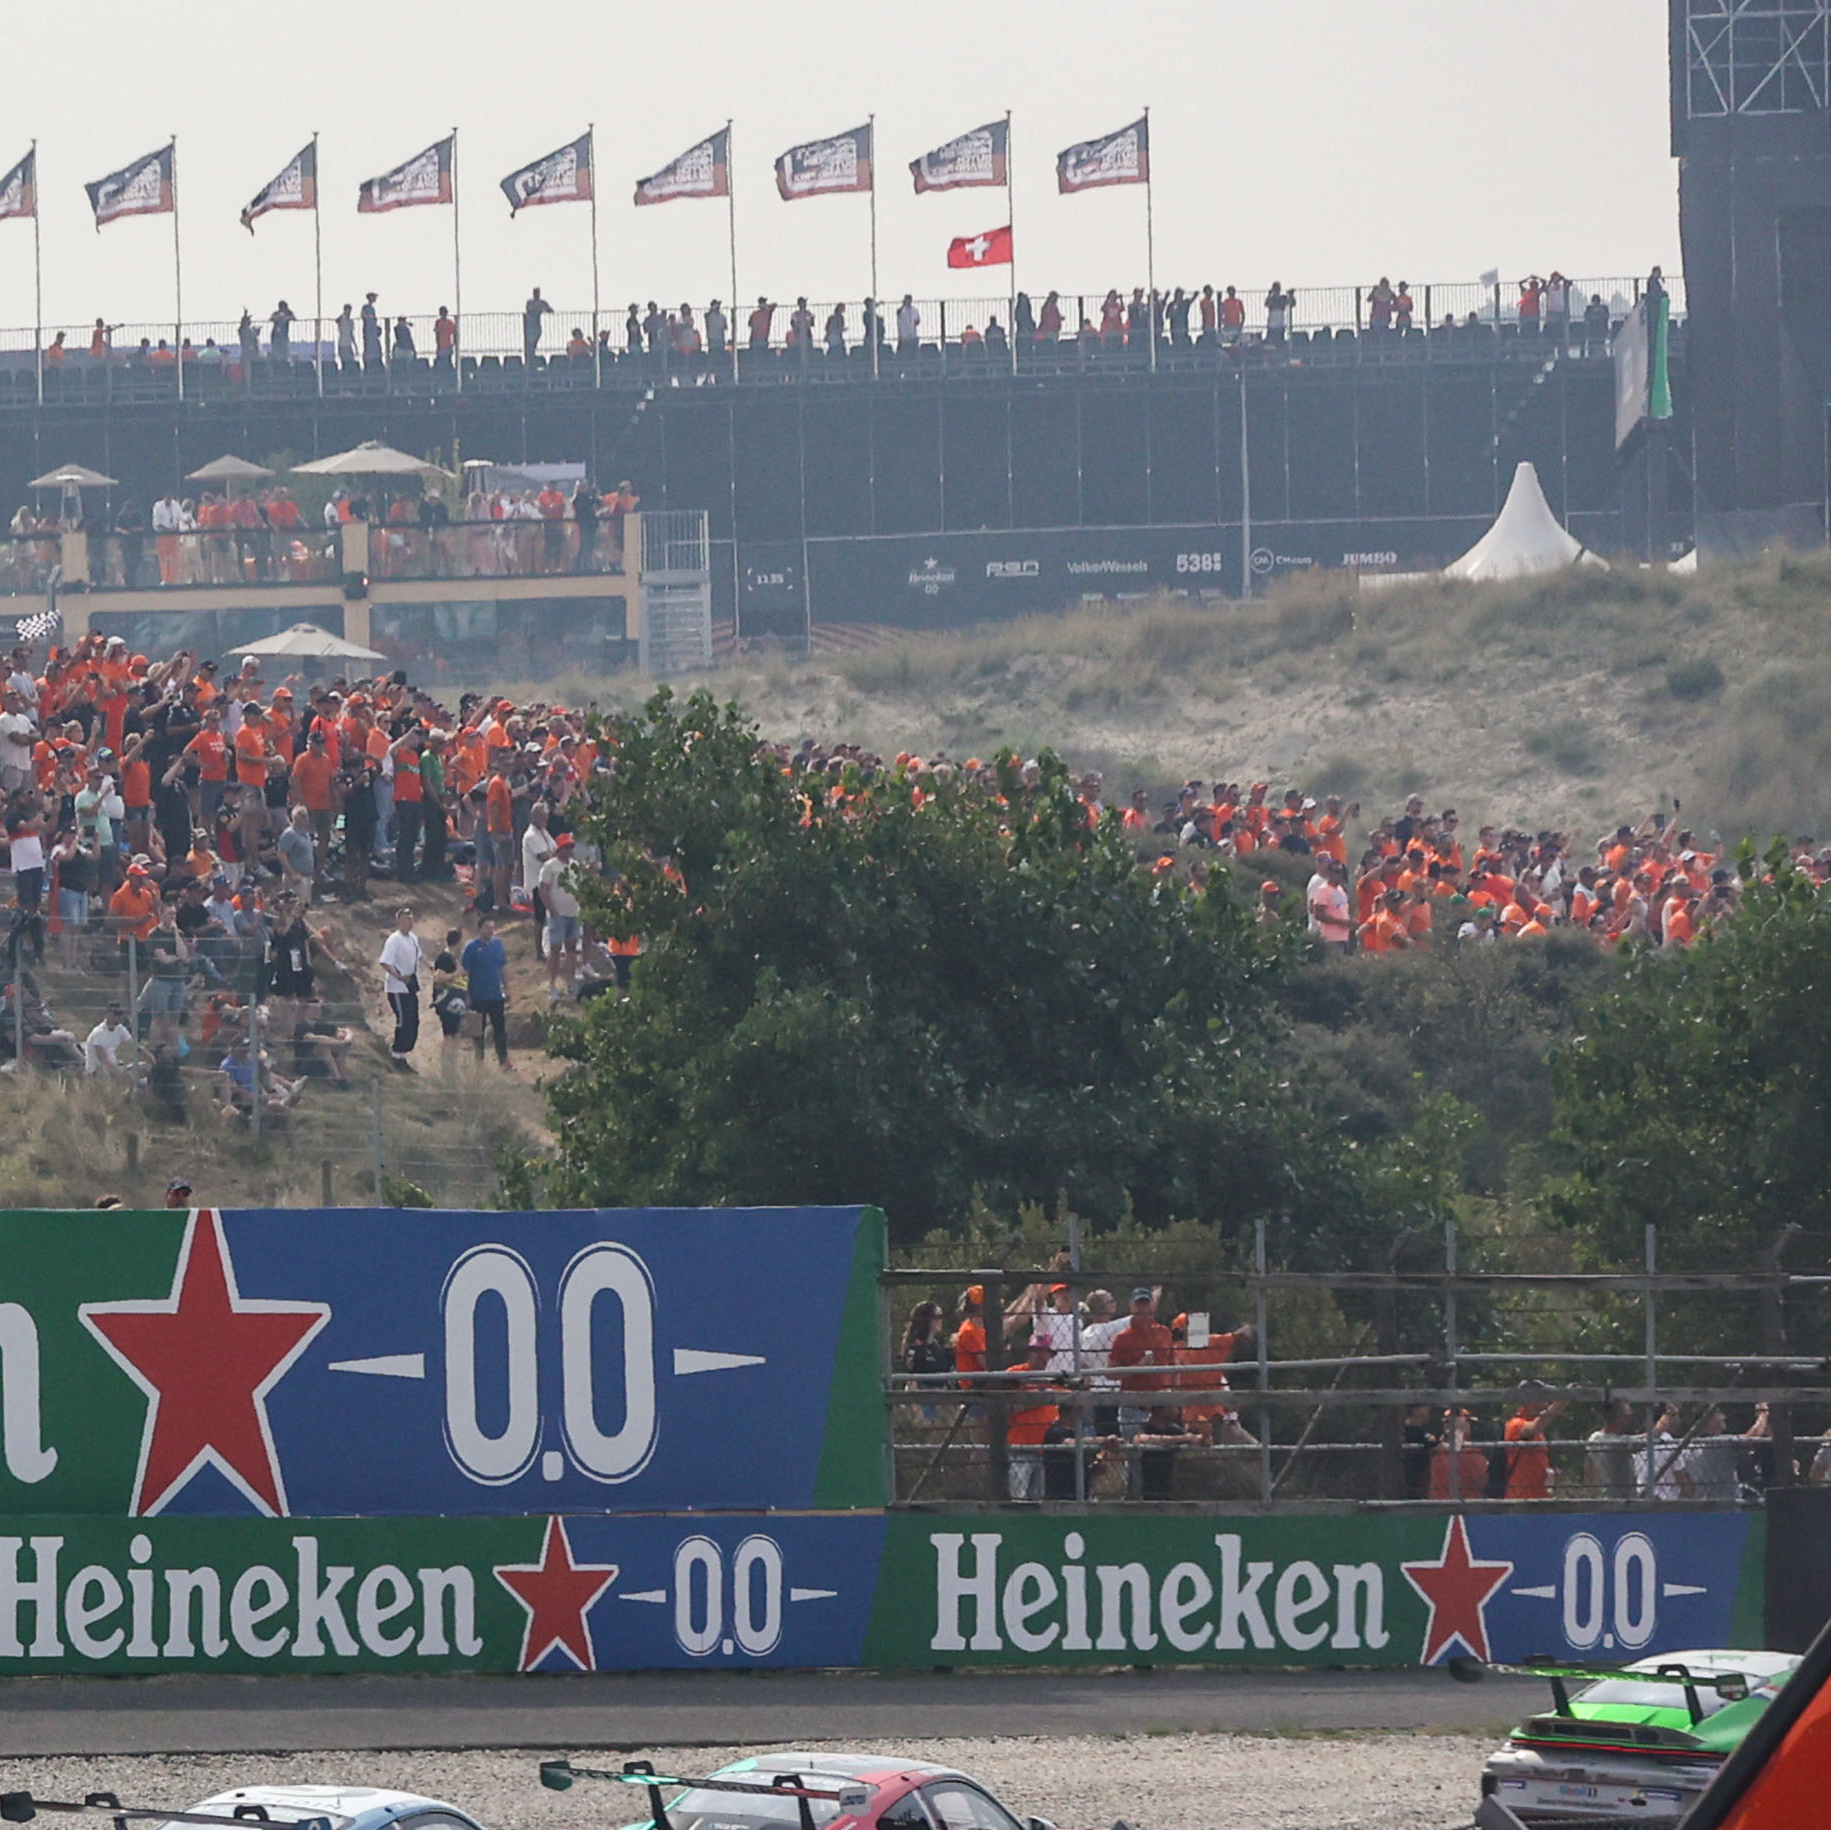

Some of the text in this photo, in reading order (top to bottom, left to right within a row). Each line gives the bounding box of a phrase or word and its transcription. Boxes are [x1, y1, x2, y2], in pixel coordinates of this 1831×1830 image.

[1177, 553, 1211, 573] 538
[1341, 552, 1397, 566] JUMBO
[443, 1246, 655, 1479] 0.0
[674, 1535, 783, 1655] 0.0
[931, 1534, 1388, 1651] Heineken
[1562, 1533, 1657, 1649] 0.0
